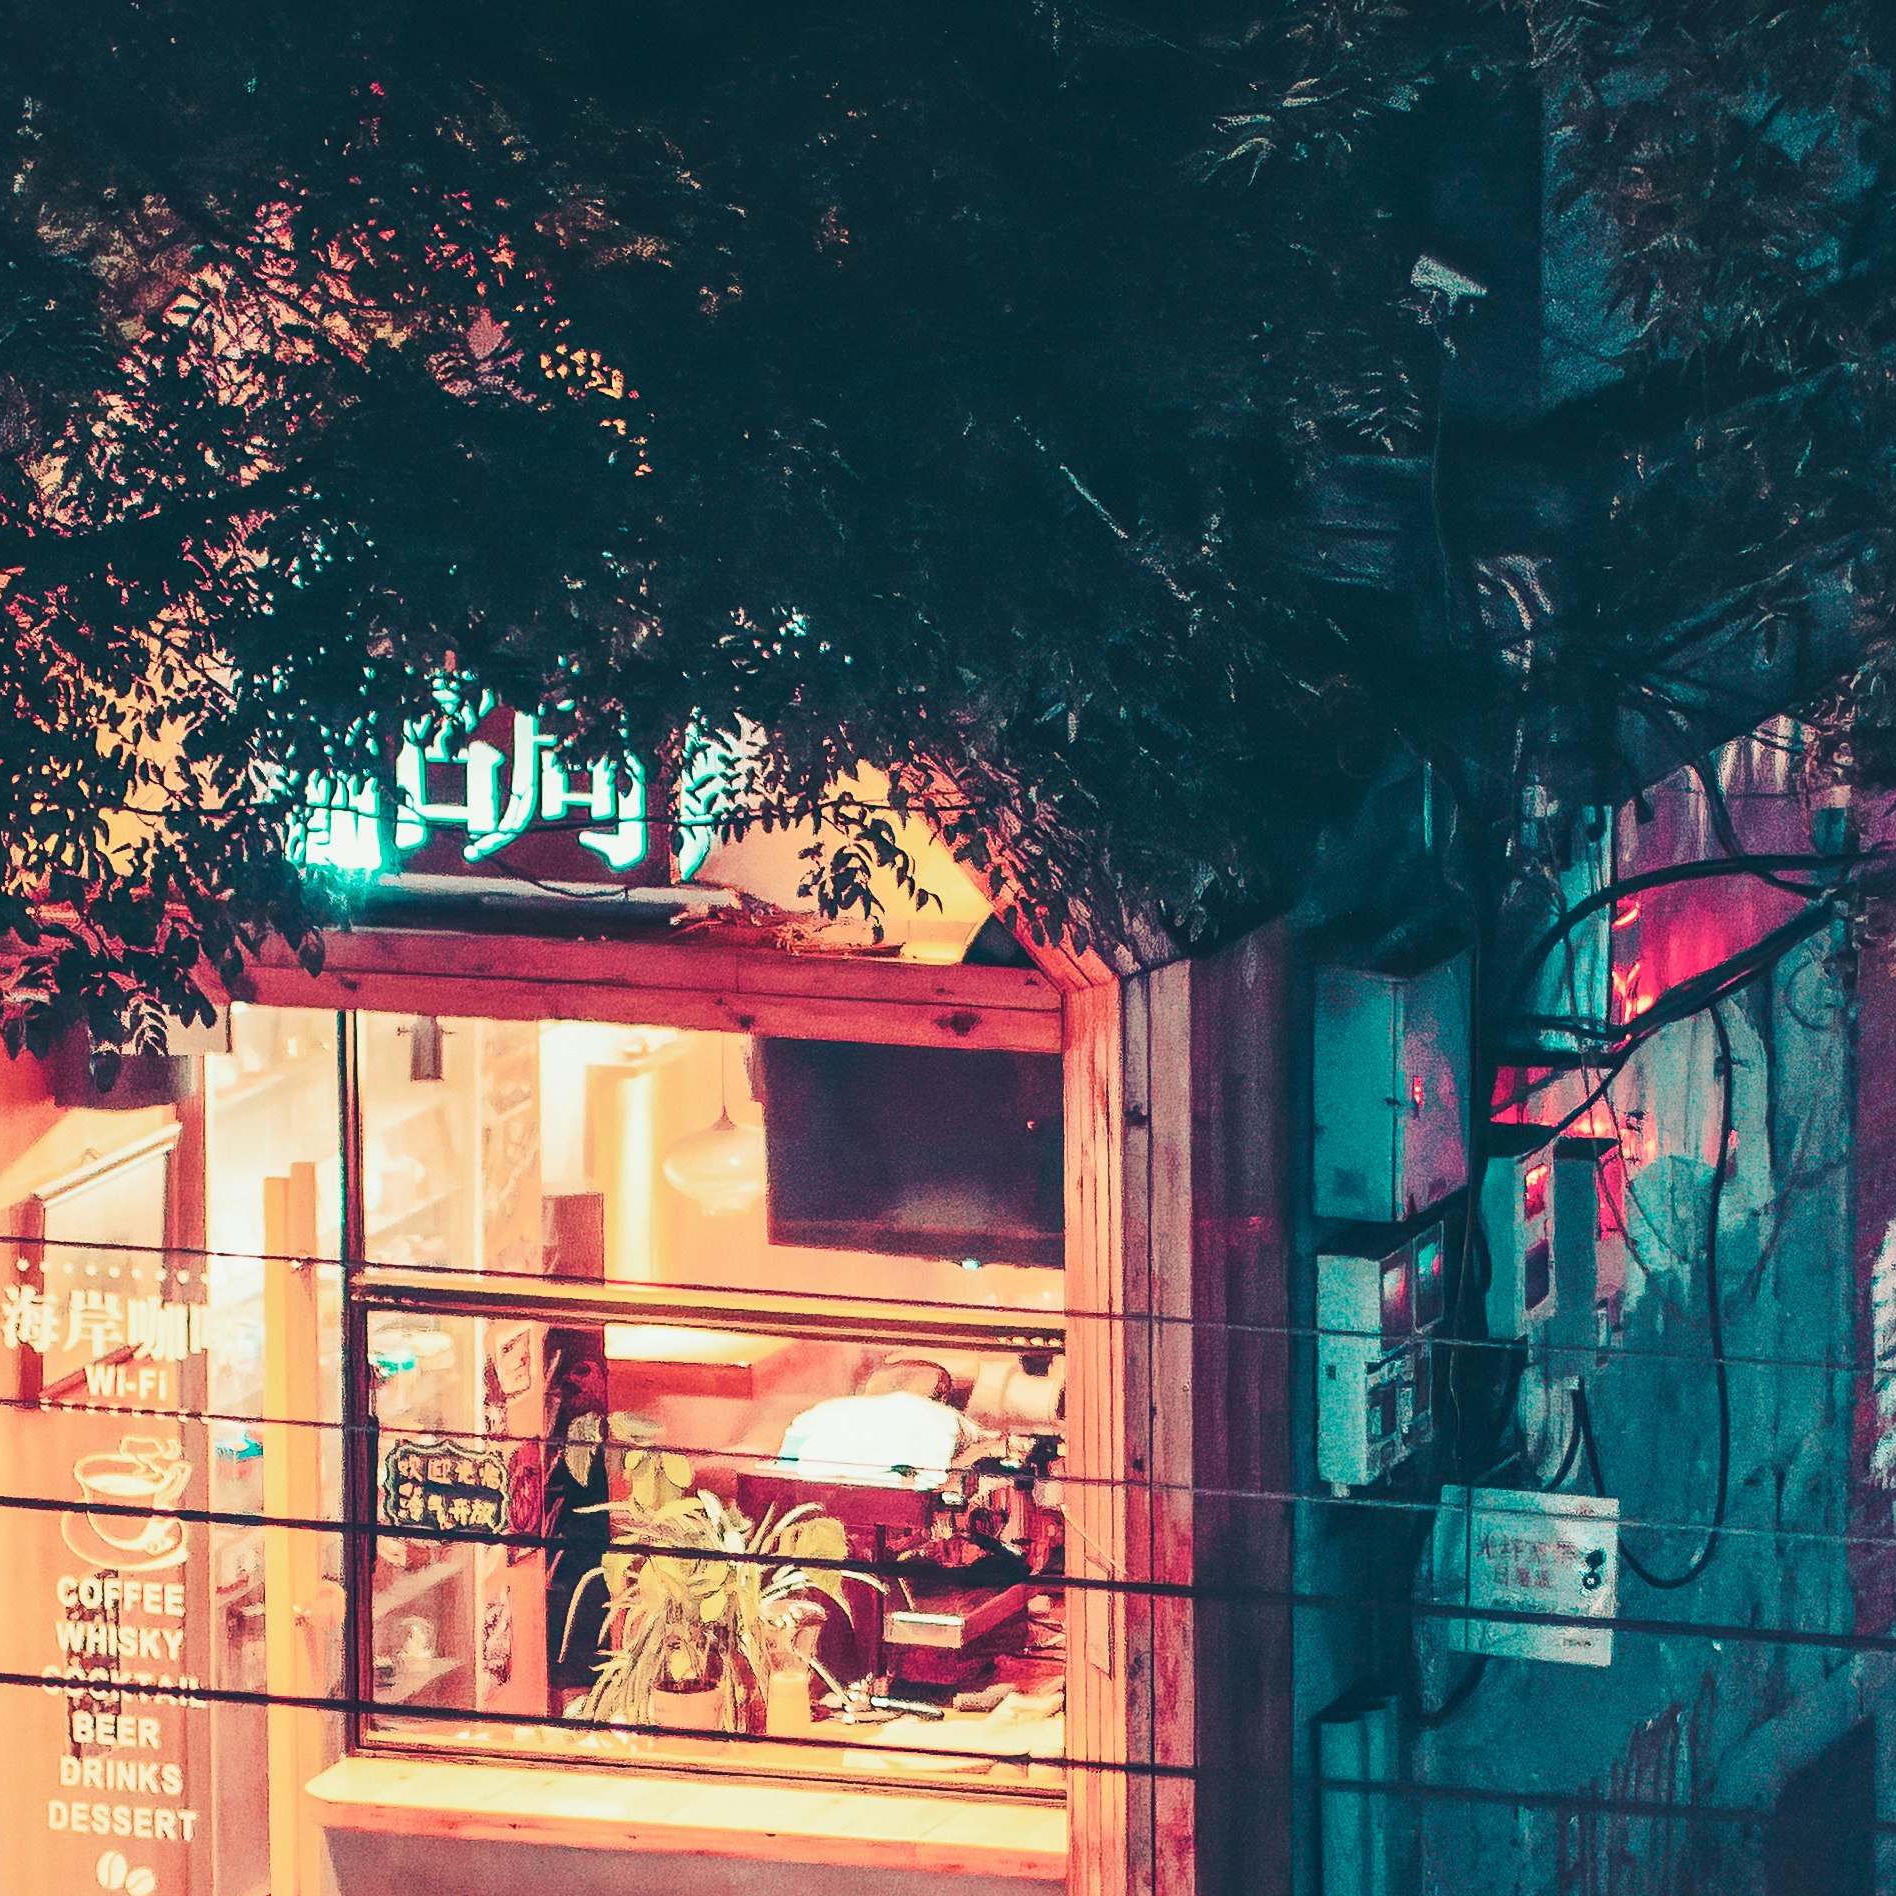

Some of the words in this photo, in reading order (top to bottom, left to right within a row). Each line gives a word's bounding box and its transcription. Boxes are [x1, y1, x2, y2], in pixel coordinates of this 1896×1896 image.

[1, 1283, 211, 1363] 海岸咖
[85, 1363, 168, 1402] Wi-Fi
[56, 1575, 186, 1617] COFFEE
[55, 1619, 184, 1661] WHISKY
[71, 1709, 162, 1750] BEER
[59, 1755, 185, 1796] DRINKS
[47, 1800, 200, 1842] DESSERT
